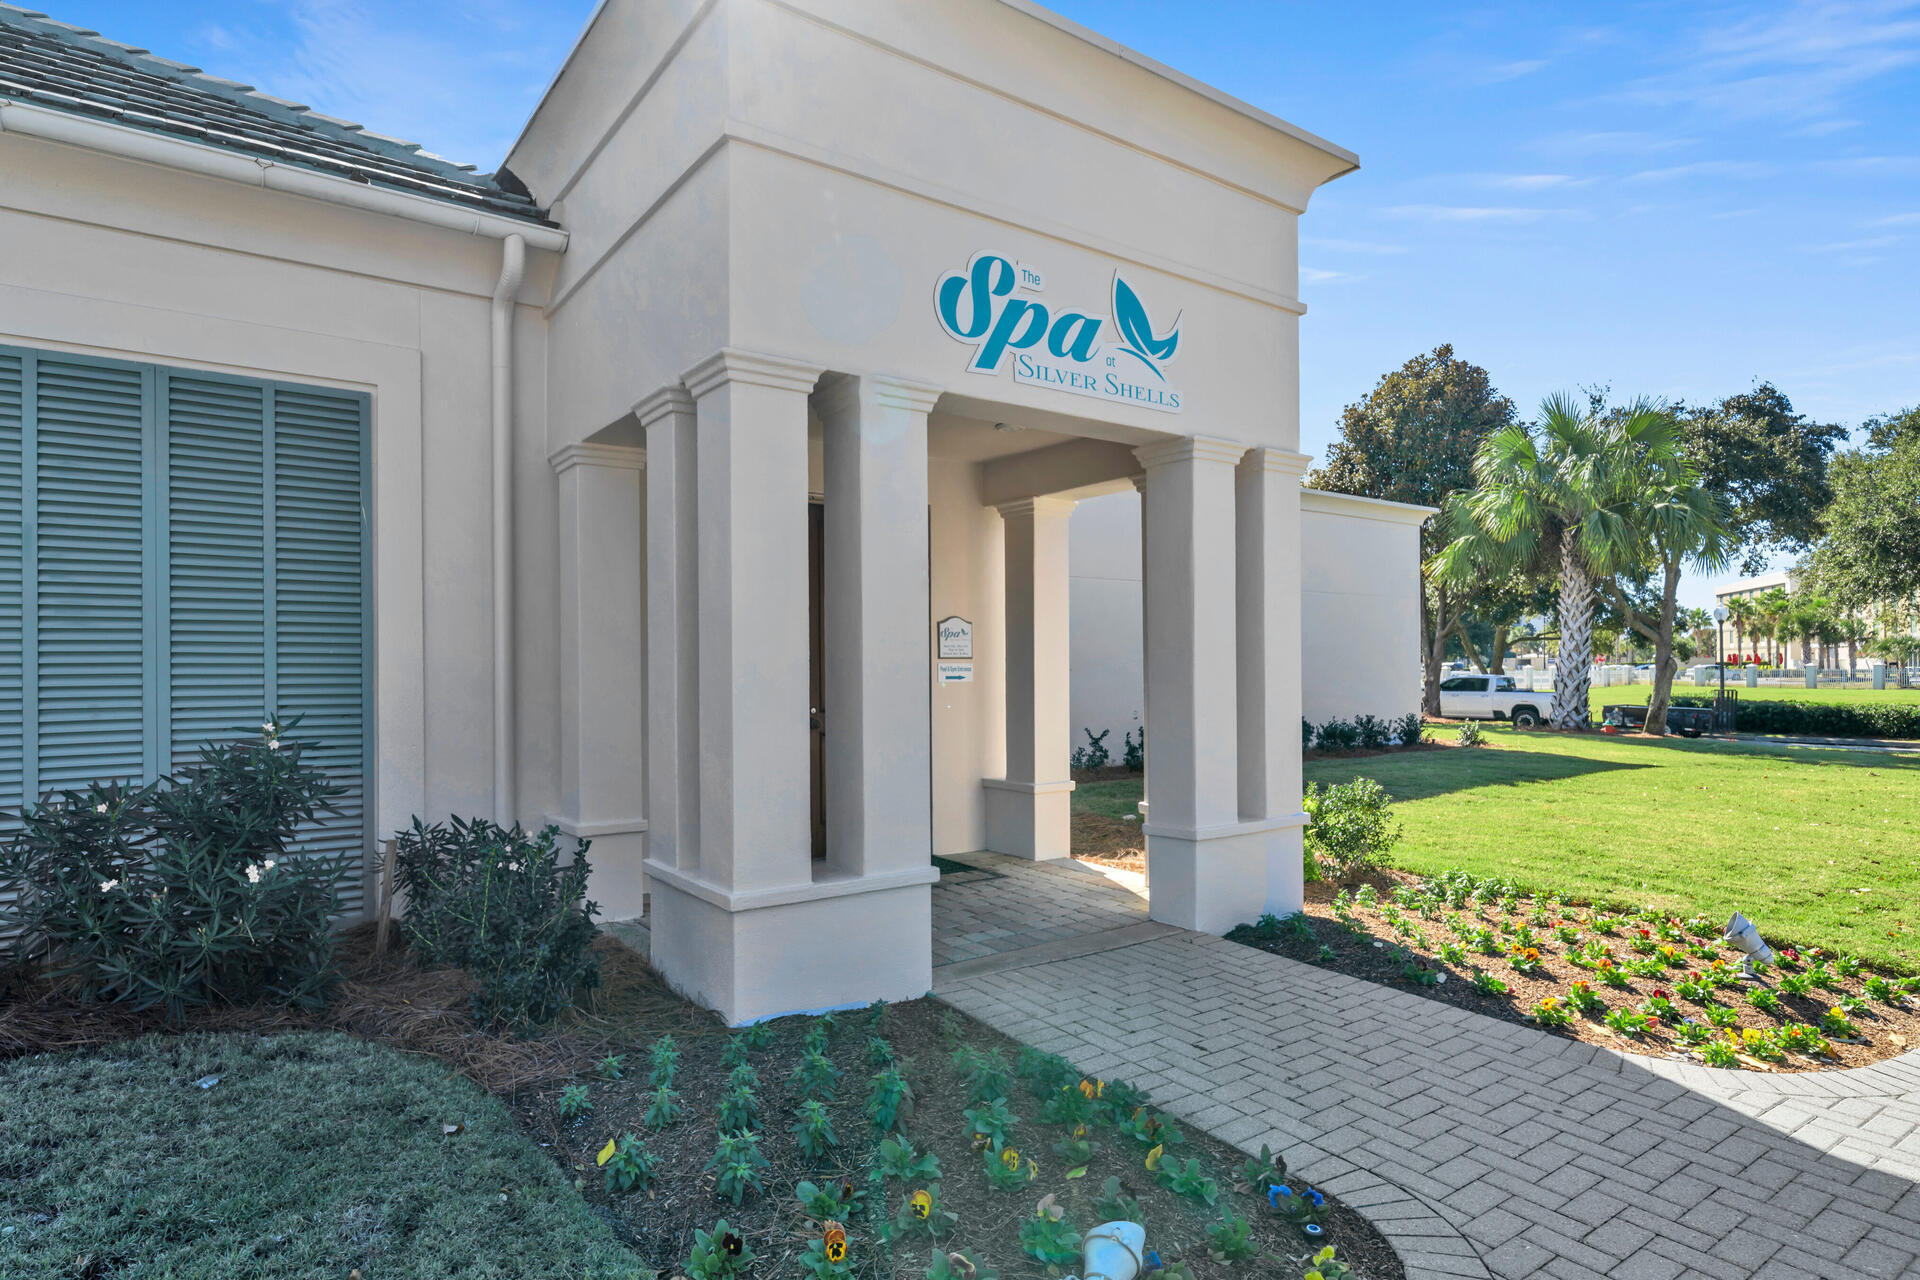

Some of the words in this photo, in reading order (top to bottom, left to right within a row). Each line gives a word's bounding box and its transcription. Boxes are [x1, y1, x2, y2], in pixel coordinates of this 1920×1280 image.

[1021, 269, 1041, 286] The
[939, 255, 1103, 370] Spa
[1105, 356, 1116, 368] at
[1018, 353, 1097, 391] SILVER
[1104, 372, 1180, 408] SHELLS
[940, 628, 961, 641] Spa
